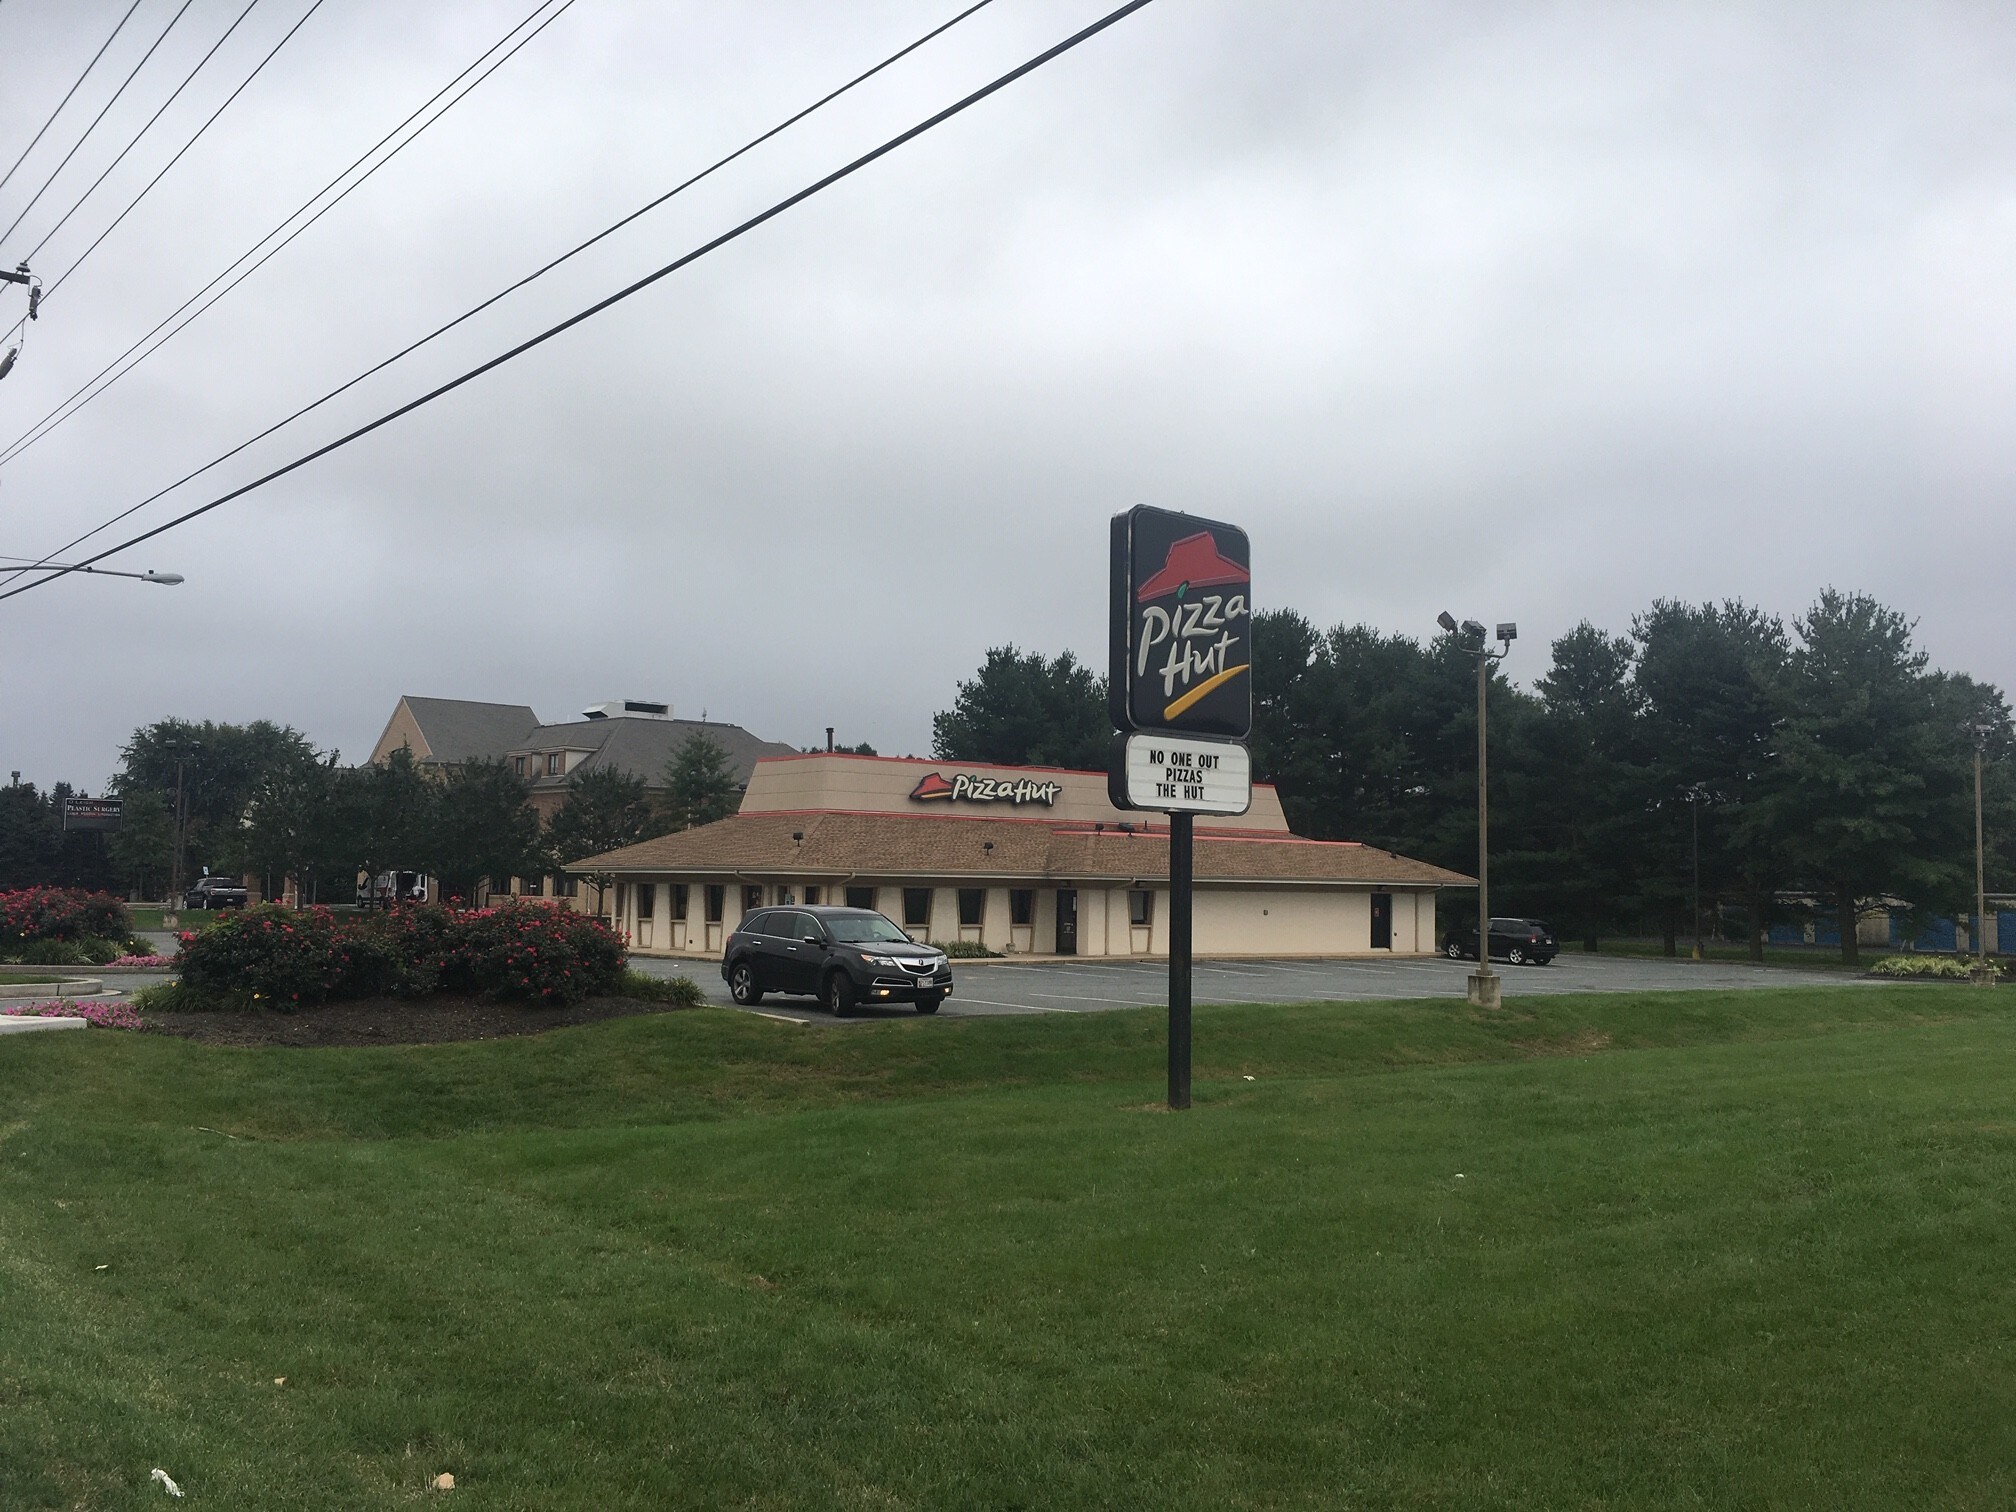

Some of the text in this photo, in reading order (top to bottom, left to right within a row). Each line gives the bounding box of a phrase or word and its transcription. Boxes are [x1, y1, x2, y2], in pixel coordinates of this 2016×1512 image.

[1137, 594, 1249, 677] Pizza
[1159, 630, 1240, 697] Hut
[1150, 750, 1219, 769] NO ONE OUT
[1166, 767, 1203, 783] PIZZAS
[952, 775, 1061, 804] Pizza Hut
[1156, 783, 1204, 800] THE HUT
